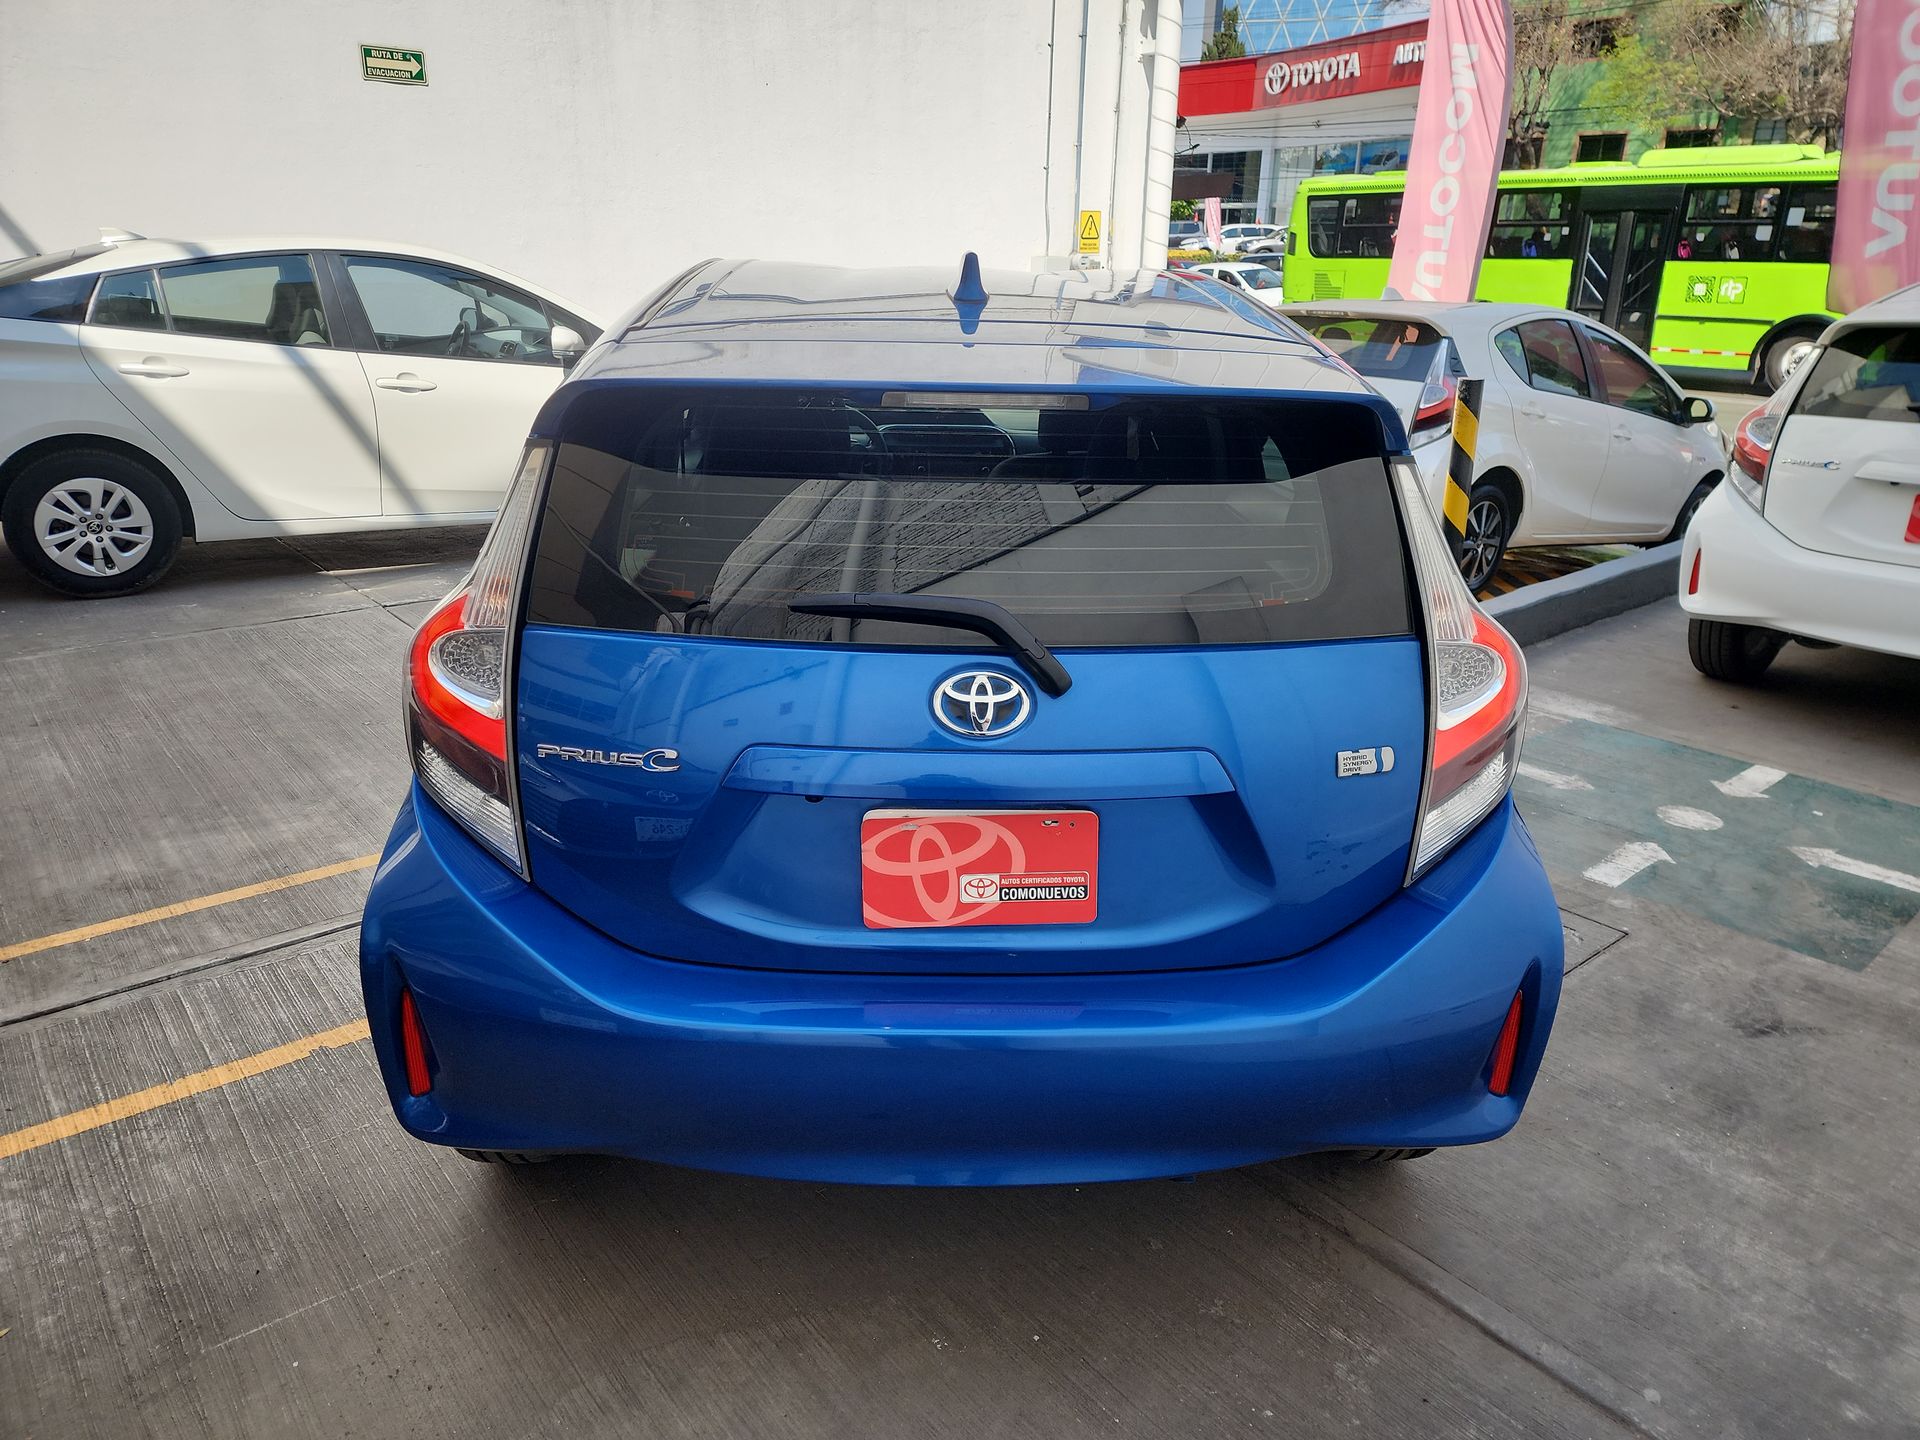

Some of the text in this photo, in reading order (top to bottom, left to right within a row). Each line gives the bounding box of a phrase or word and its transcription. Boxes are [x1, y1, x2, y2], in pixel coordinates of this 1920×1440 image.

[371, 50, 404, 60] RUTA DE
[367, 68, 411, 78] EVACUACION
[1291, 52, 1361, 88] TOYOTA
[1343, 754, 1367, 762] HYBRID
[1001, 886, 1086, 900] COMONUEVOS
